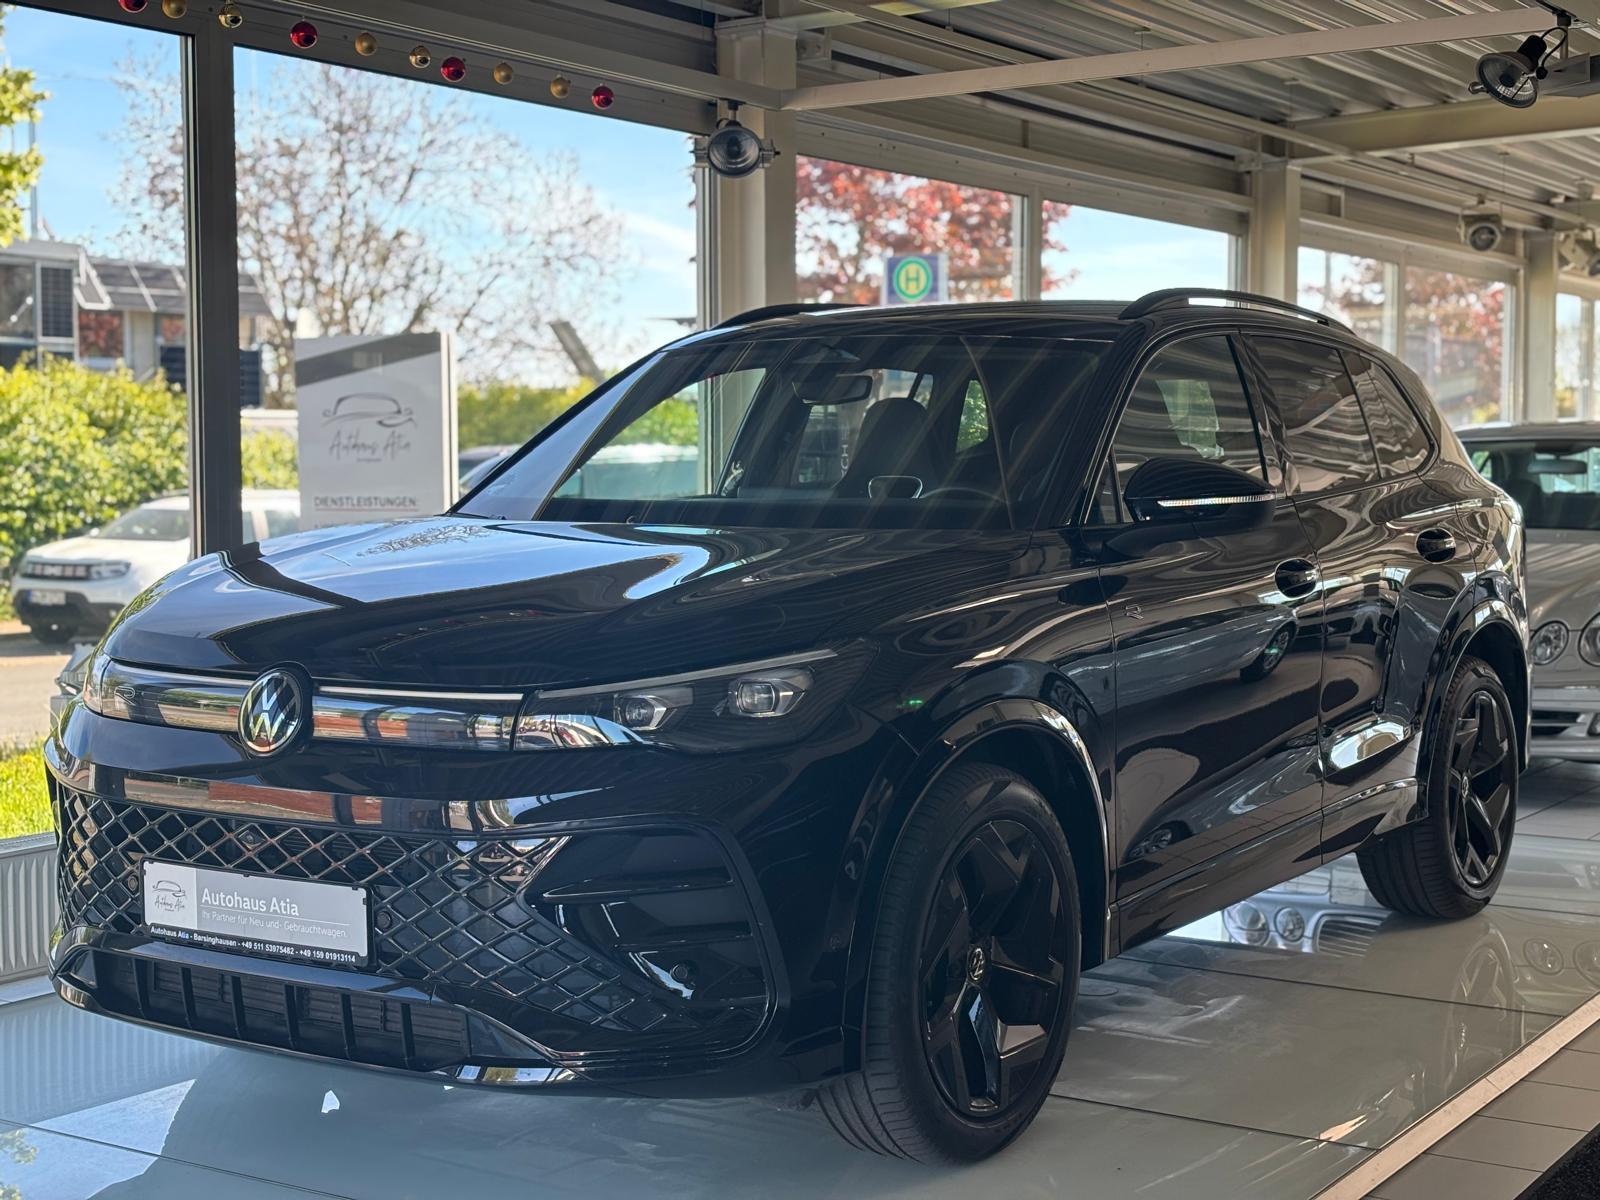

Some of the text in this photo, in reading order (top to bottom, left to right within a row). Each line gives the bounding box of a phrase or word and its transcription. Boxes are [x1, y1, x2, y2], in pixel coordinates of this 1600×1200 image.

[905, 268, 920, 290] H
[201, 887, 299, 916] Autohaus Atia
[212, 911, 236, 922] Partner
[237, 914, 248, 924] für
[249, 915, 264, 927] Neu
[150, 925, 177, 937] Autohaus
[178, 929, 189, 939] Atia
[241, 942, 253, 950] +49
[253, 941, 264, 950] 511
[299, 949, 311, 957] +49
[312, 950, 324, 959] 159
[325, 951, 356, 963] 01913114
